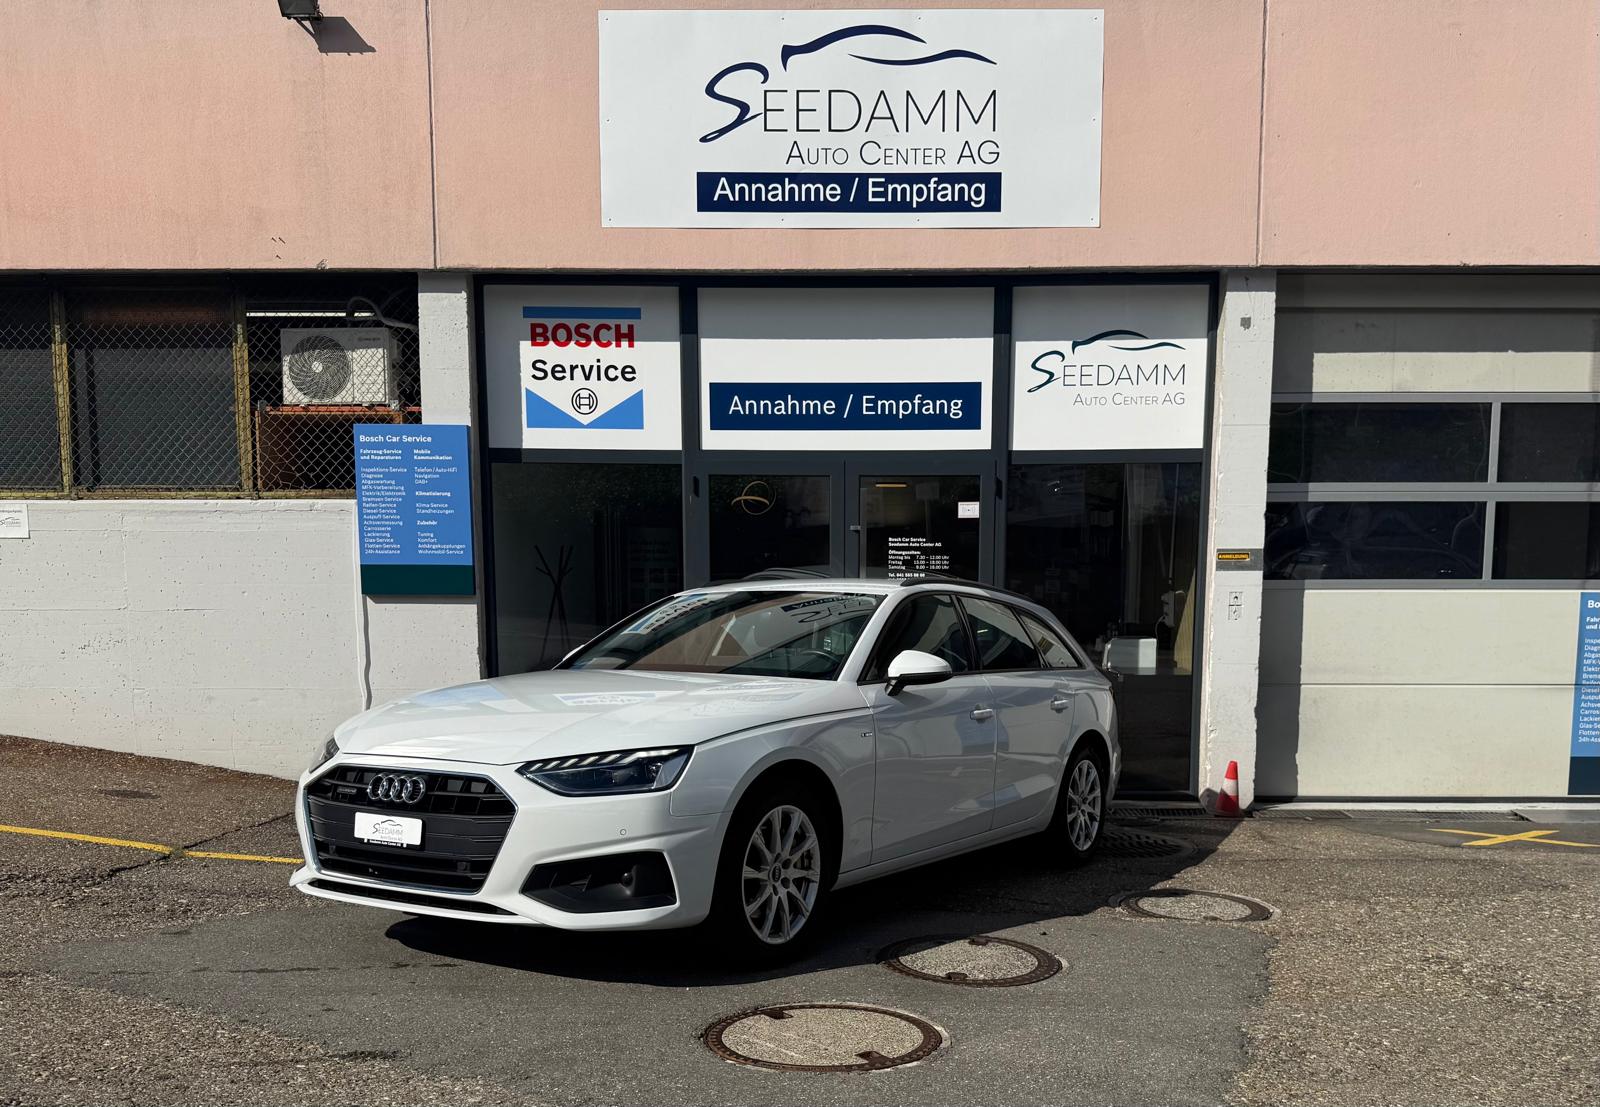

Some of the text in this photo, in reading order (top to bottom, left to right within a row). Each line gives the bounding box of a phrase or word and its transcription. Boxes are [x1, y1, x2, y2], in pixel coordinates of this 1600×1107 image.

[699, 62, 997, 143] SEEDAMM
[957, 141, 1000, 165] AG
[713, 178, 986, 207] Annahme / Empfang
[530, 323, 635, 348] BOSCH
[531, 359, 637, 382] Service
[1027, 350, 1186, 393] SEEDAMM
[729, 394, 963, 419] Annahme / Empfang
[1162, 392, 1186, 406] AG
